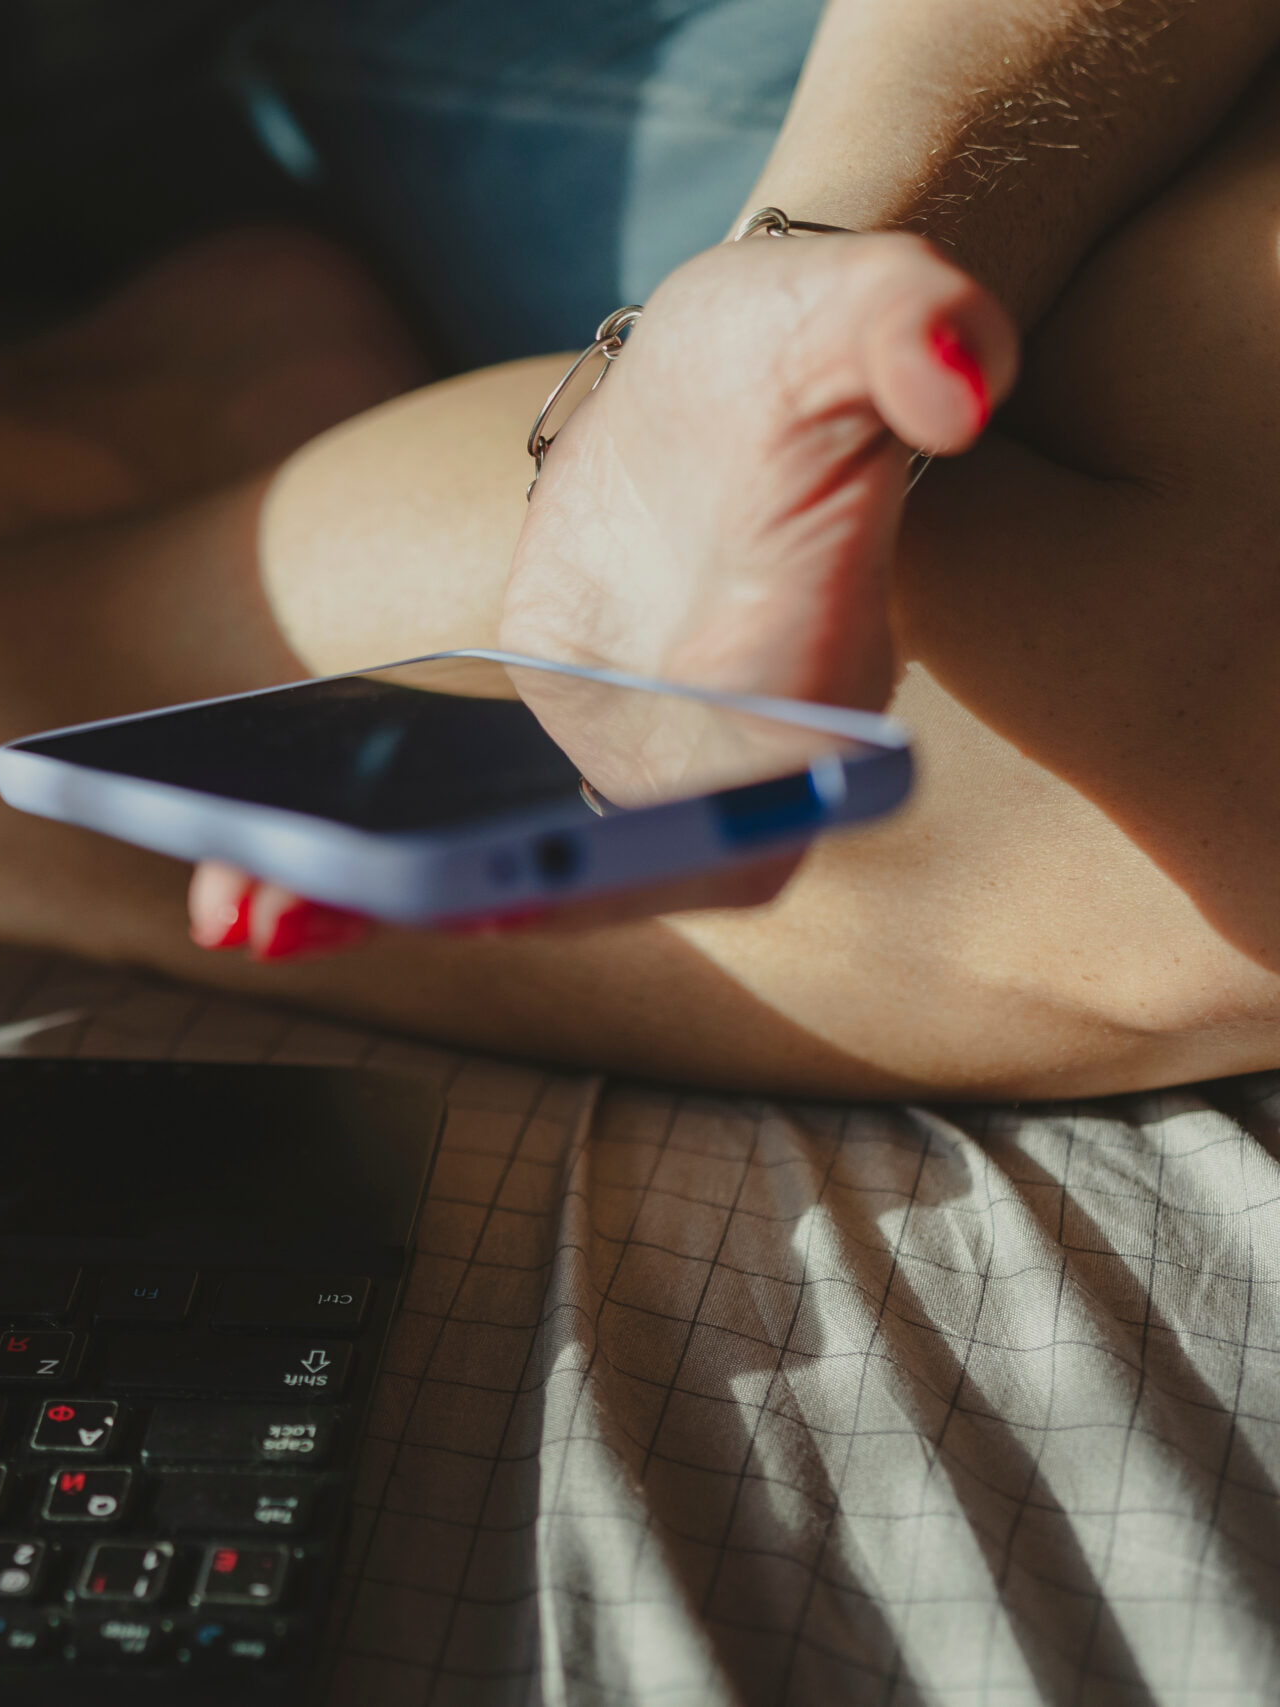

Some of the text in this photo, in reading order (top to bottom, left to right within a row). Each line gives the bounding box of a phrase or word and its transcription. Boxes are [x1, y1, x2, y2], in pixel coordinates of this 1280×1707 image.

[318, 1295, 352, 1304] Ctrl
[8, 1337, 28, 1352] Я
[37, 1360, 59, 1374] Z
[284, 1375, 327, 1386] Shift
[48, 1406, 74, 1421] Ф
[270, 1425, 316, 1440] Lock
[264, 1435, 314, 1452] Caps
[88, 1496, 116, 1516] Q
[14, 1545, 34, 1564] 2
